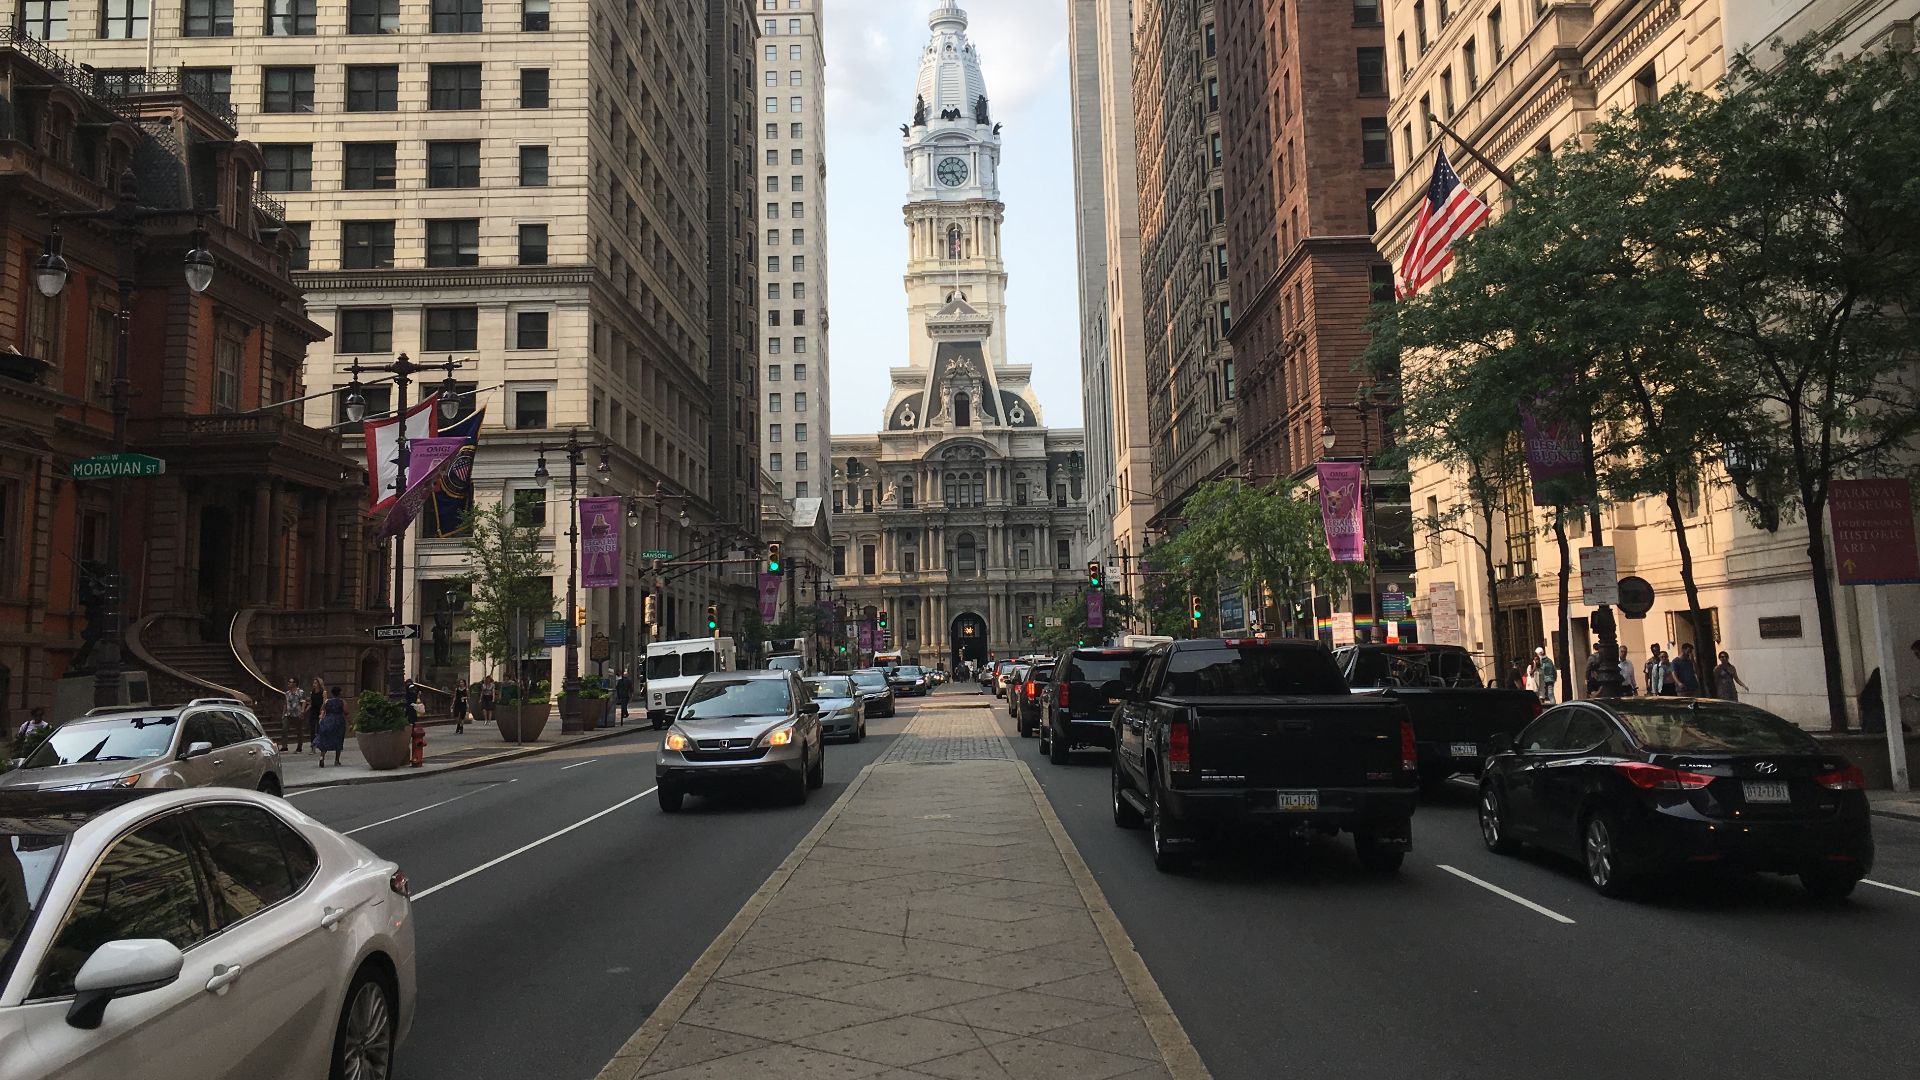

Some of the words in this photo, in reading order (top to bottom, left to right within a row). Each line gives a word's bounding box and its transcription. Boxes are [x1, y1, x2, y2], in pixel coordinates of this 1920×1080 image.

[426, 445, 451, 453] OMG!
[73, 461, 141, 477] MORAVIAN
[145, 464, 157, 474] ST
[1834, 487, 1897, 498] PARKWAY
[1835, 500, 1903, 512] MUSEUMS
[1839, 529, 1904, 540] HISTORIC
[1841, 543, 1880, 553] AREA
